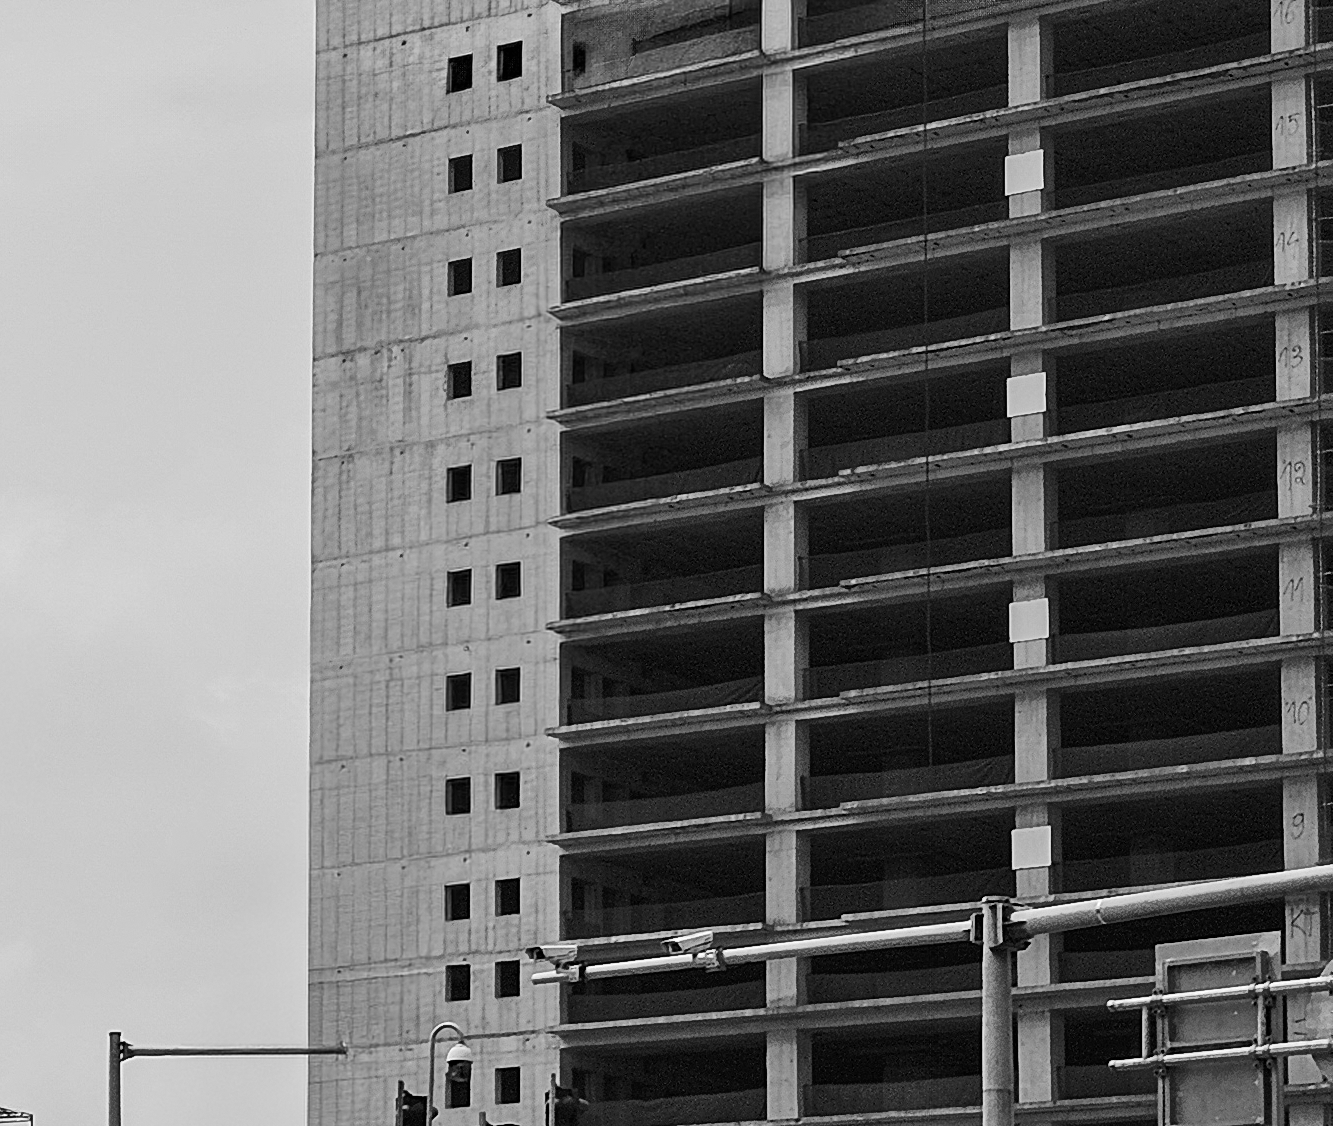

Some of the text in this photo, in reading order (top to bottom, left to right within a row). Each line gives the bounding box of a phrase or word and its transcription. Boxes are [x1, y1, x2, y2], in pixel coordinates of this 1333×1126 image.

[1275, 112, 1300, 136] 15
[1278, 345, 1303, 369] 13
[1280, 460, 1306, 491] 12
[1283, 577, 1303, 601] 11
[1287, 700, 1310, 725] 10
[1291, 812, 1305, 839] 9
